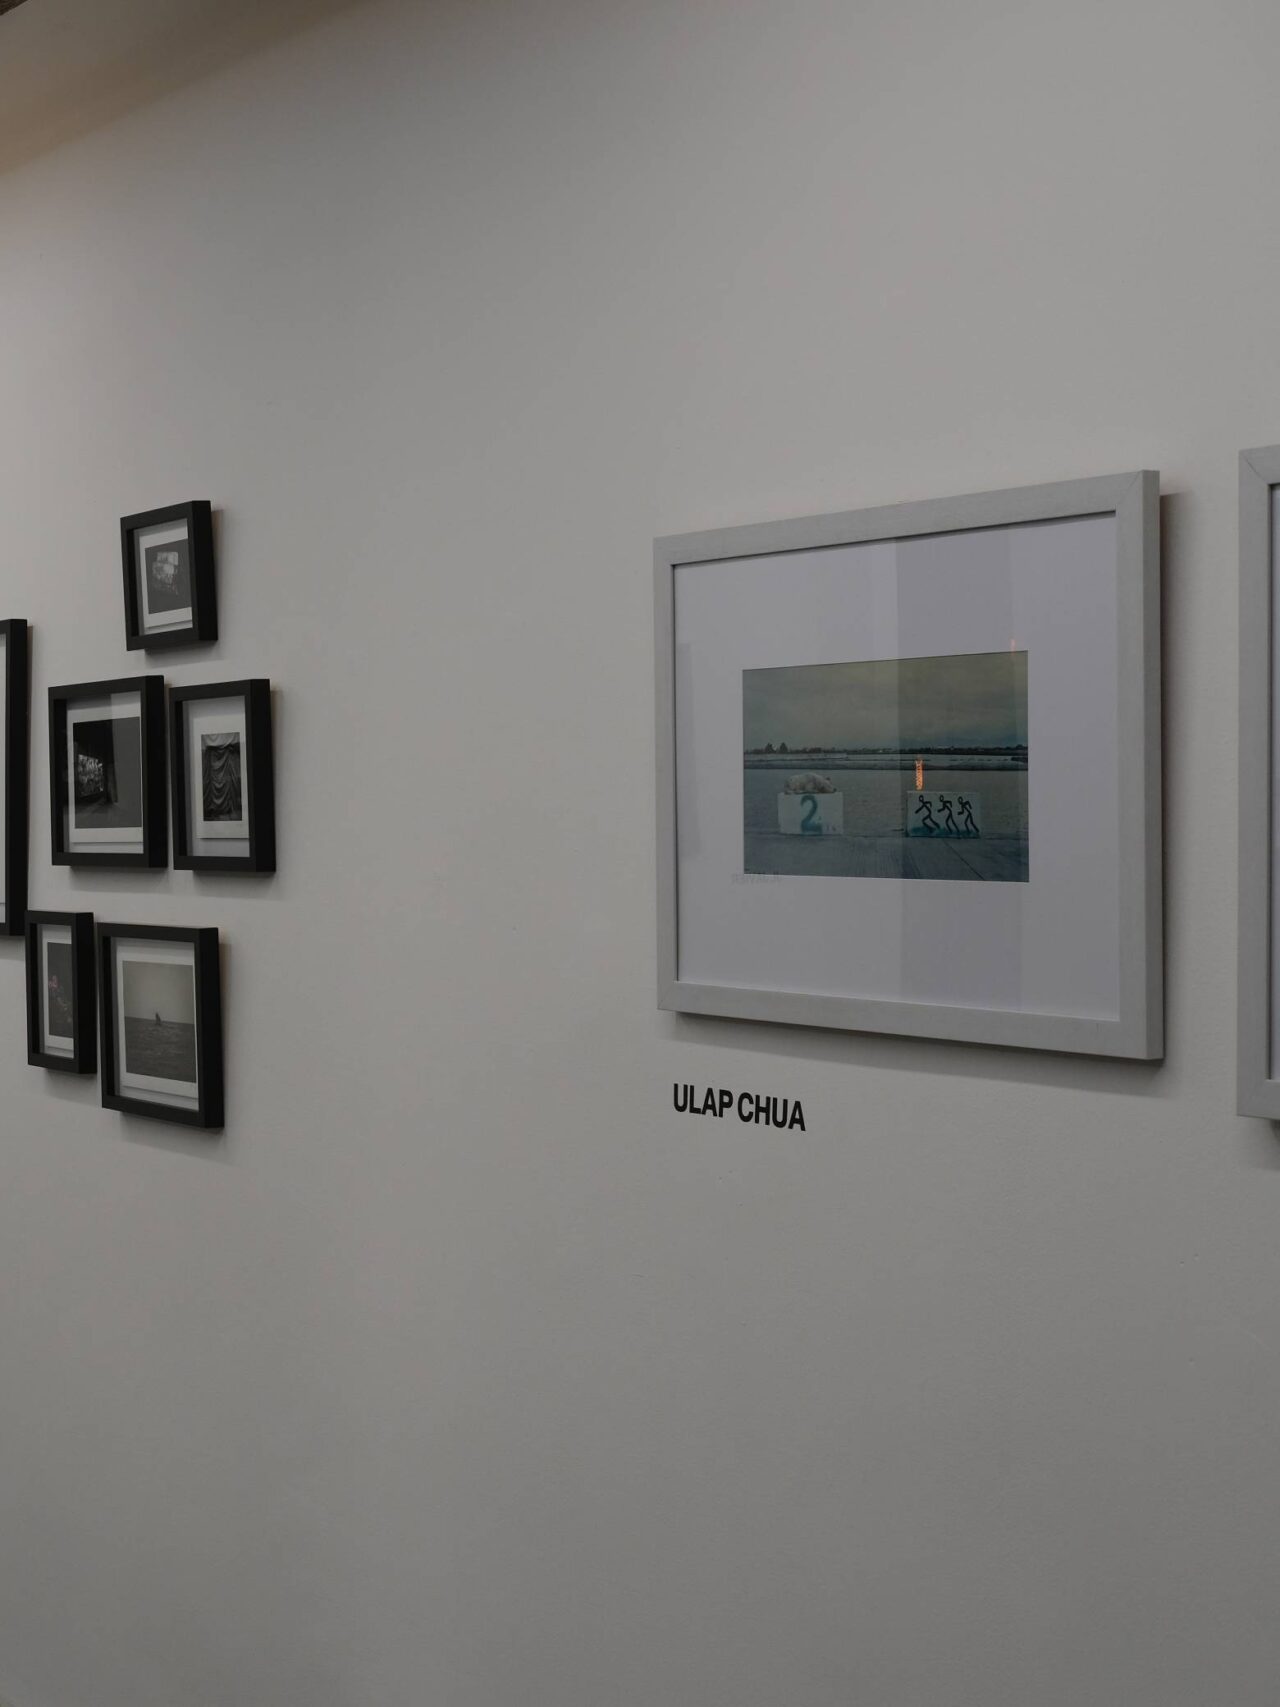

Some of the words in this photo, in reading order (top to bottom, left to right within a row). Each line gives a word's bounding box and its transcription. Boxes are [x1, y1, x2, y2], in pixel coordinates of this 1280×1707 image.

[800, 794, 823, 833] 2
[673, 1083, 734, 1118] ULAP
[737, 1092, 806, 1132] CHUA
